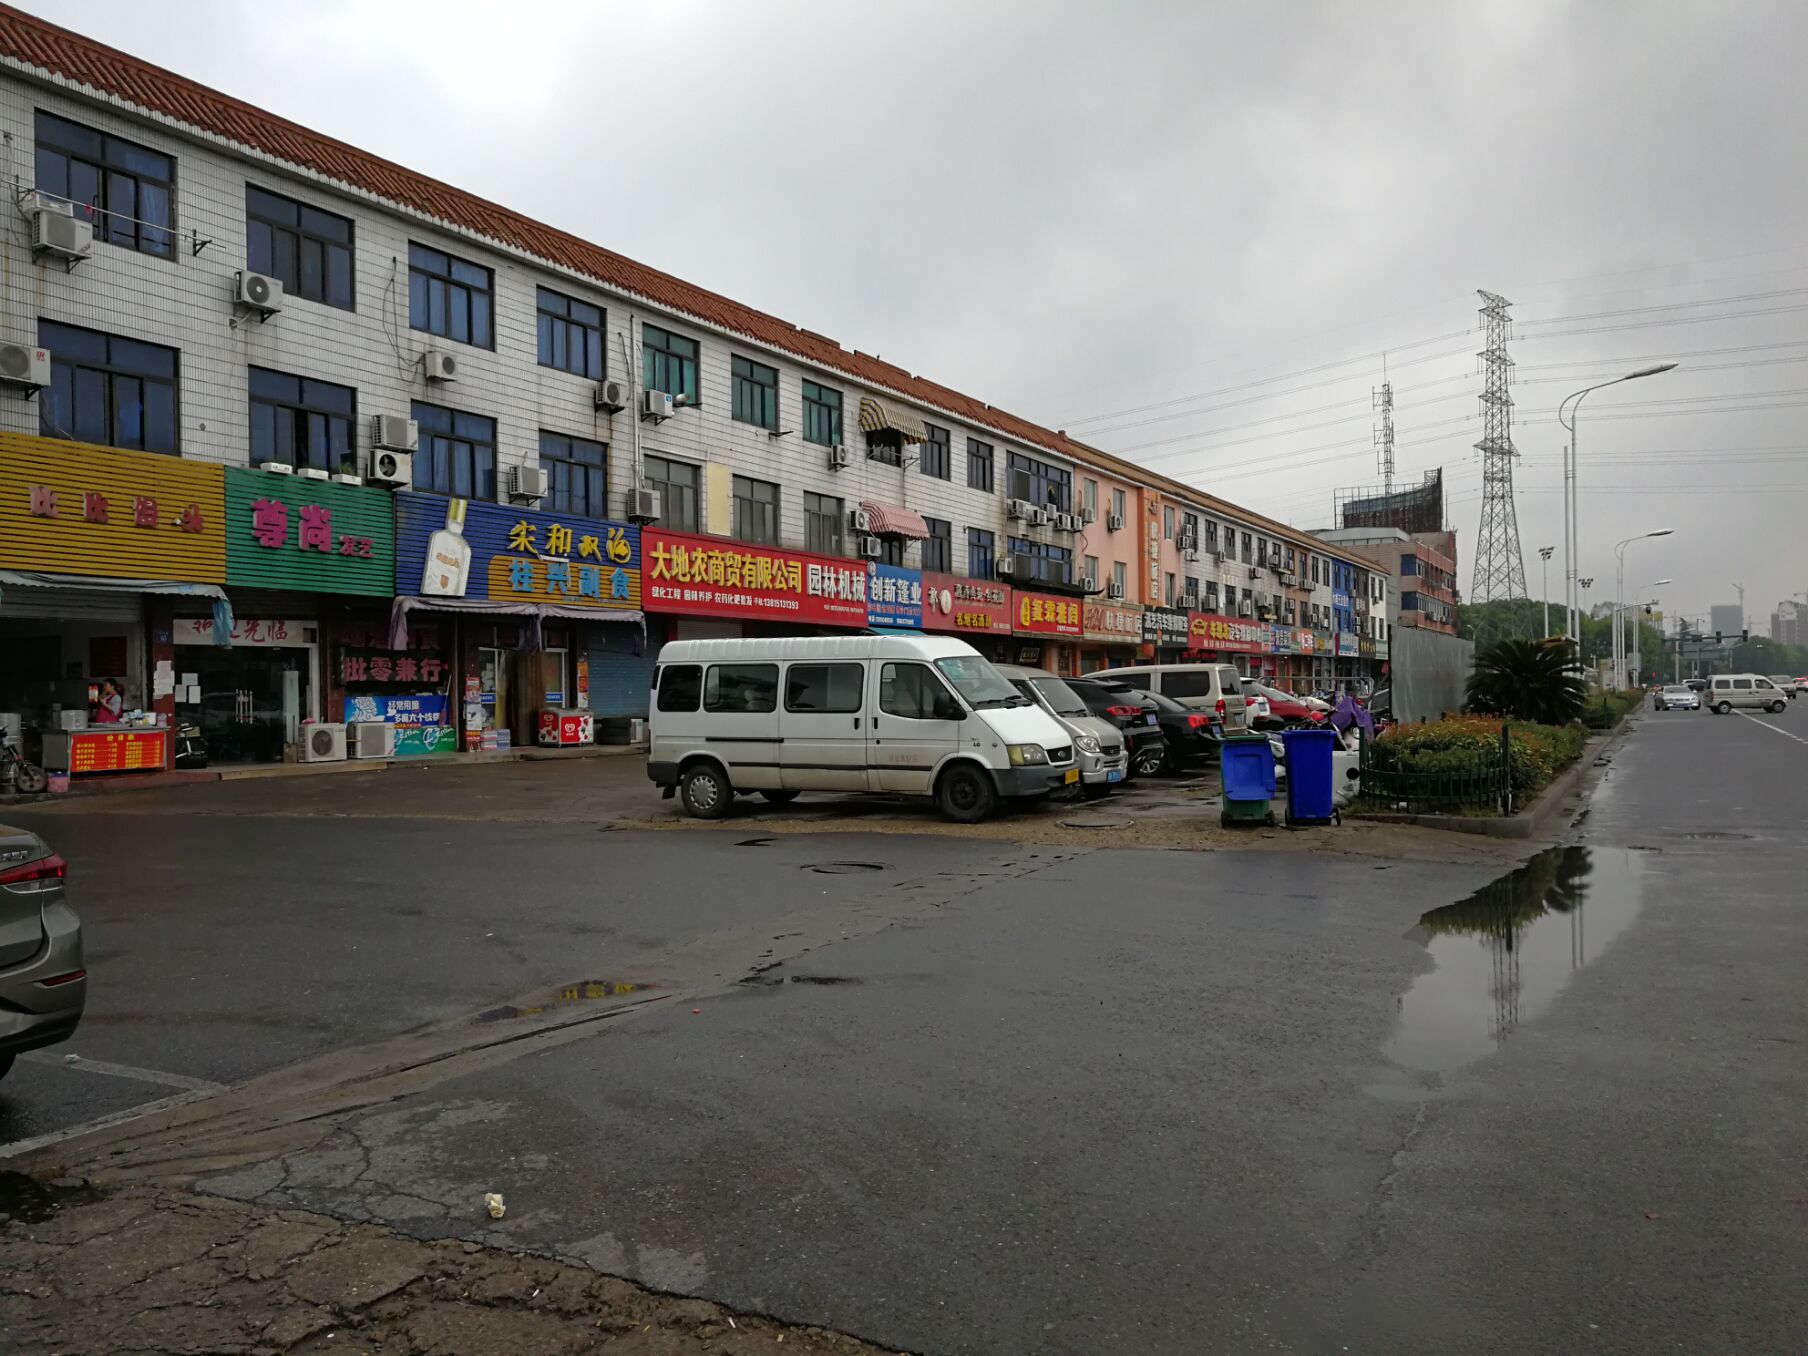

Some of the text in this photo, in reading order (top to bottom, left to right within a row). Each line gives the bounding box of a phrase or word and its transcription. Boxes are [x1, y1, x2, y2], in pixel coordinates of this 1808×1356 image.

[250, 498, 333, 553] 尊尚
[649, 541, 866, 603] 大地农商贸有限公司 园林机械
[343, 656, 442, 682] 批零兼行
